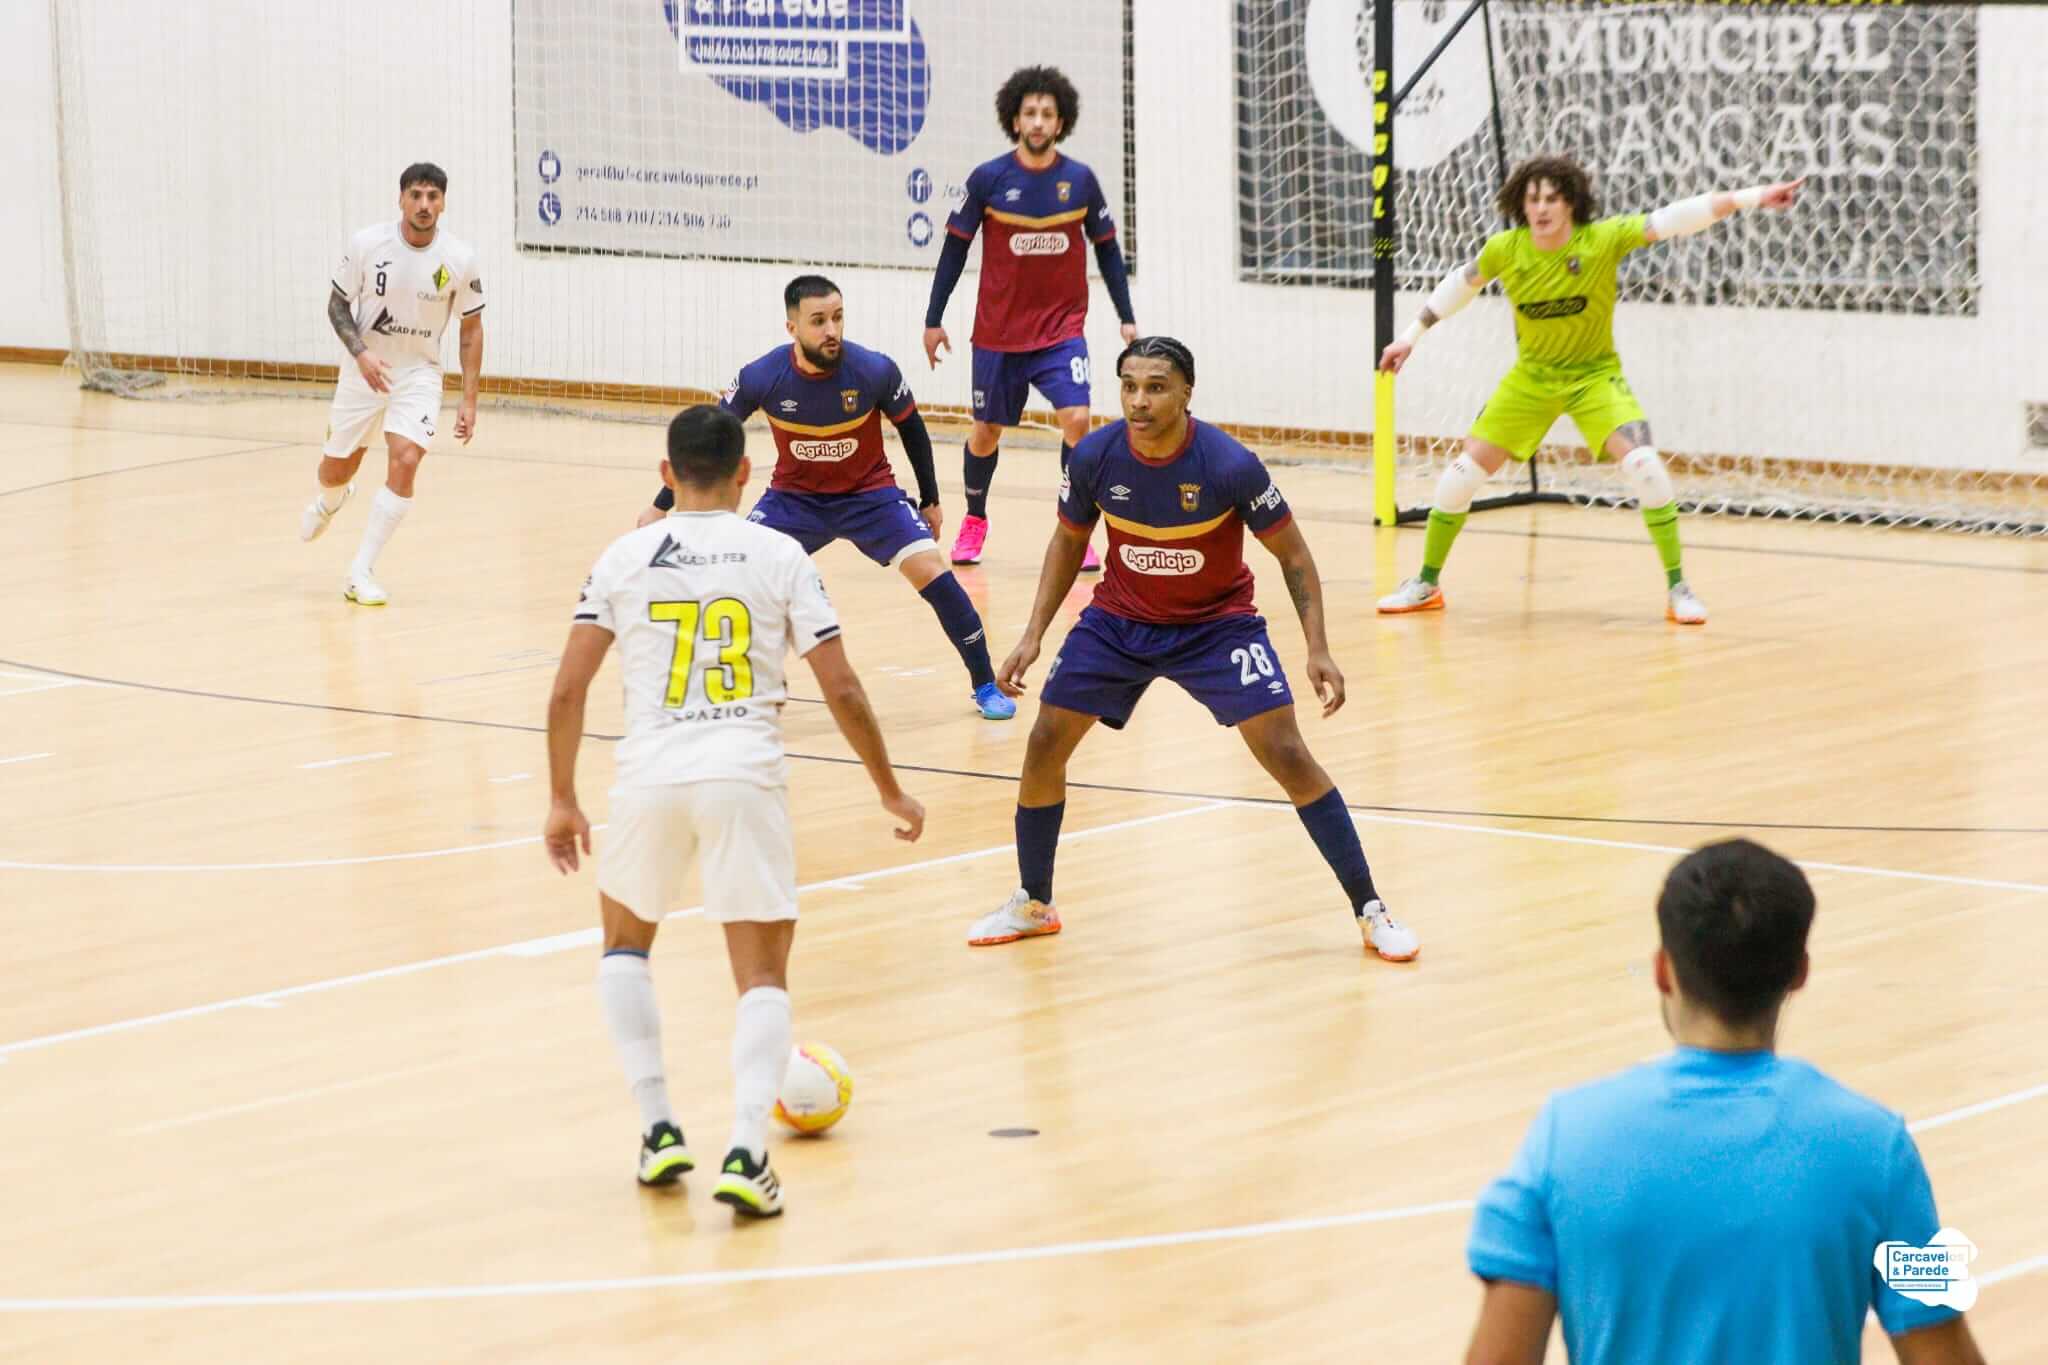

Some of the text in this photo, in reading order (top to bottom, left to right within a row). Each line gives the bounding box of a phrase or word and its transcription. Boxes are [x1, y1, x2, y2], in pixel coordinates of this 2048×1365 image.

[1546, 16, 1891, 73] MUNICIPAL
[1549, 103, 1895, 176] CASCAIS
[375, 271, 387, 297] 9
[796, 442, 852, 459] Agriloja
[1127, 548, 1197, 573] Agriloja
[648, 596, 754, 709] 73
[1230, 643, 1276, 687] 28
